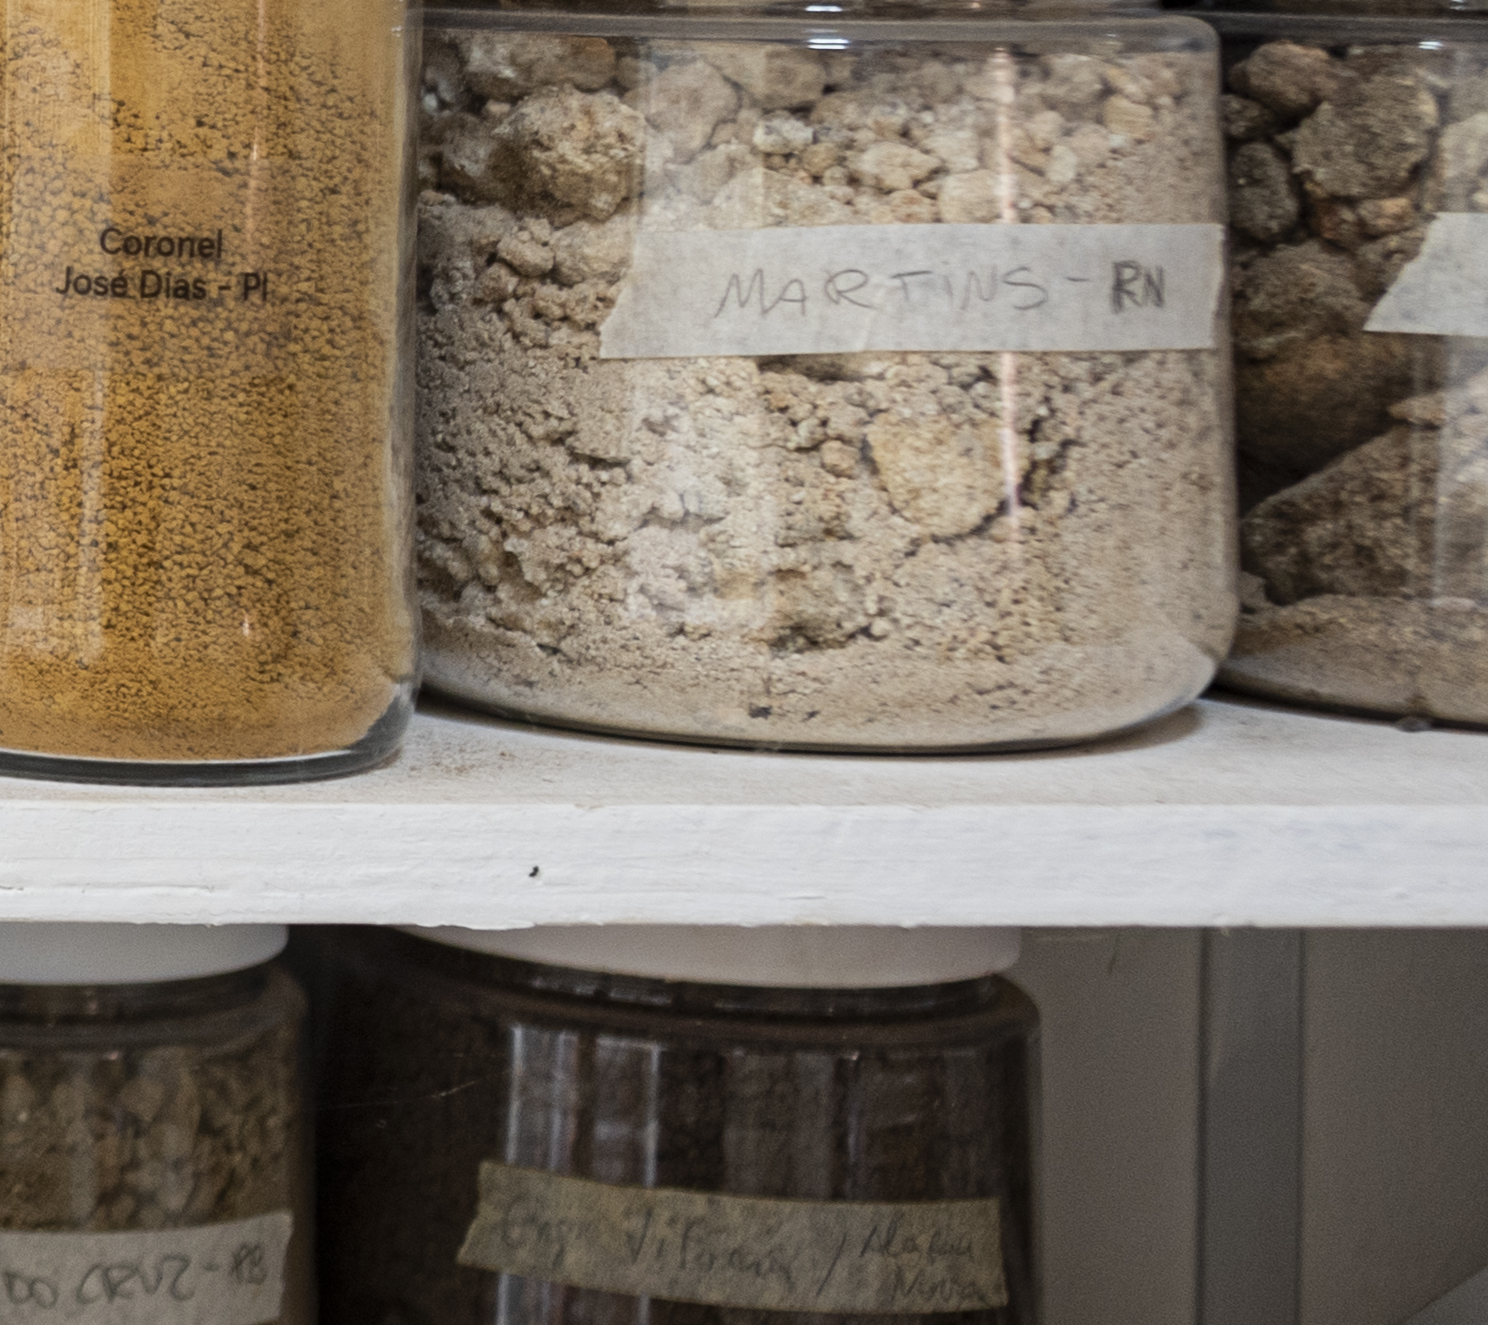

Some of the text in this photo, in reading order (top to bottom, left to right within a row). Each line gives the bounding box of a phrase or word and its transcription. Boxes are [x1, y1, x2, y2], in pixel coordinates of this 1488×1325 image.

[99, 227, 223, 259] Coronel
[55, 266, 129, 298] José
[139, 269, 207, 300] Dias
[242, 272, 269, 302] PI
[1111, 260, 1166, 313] RN
